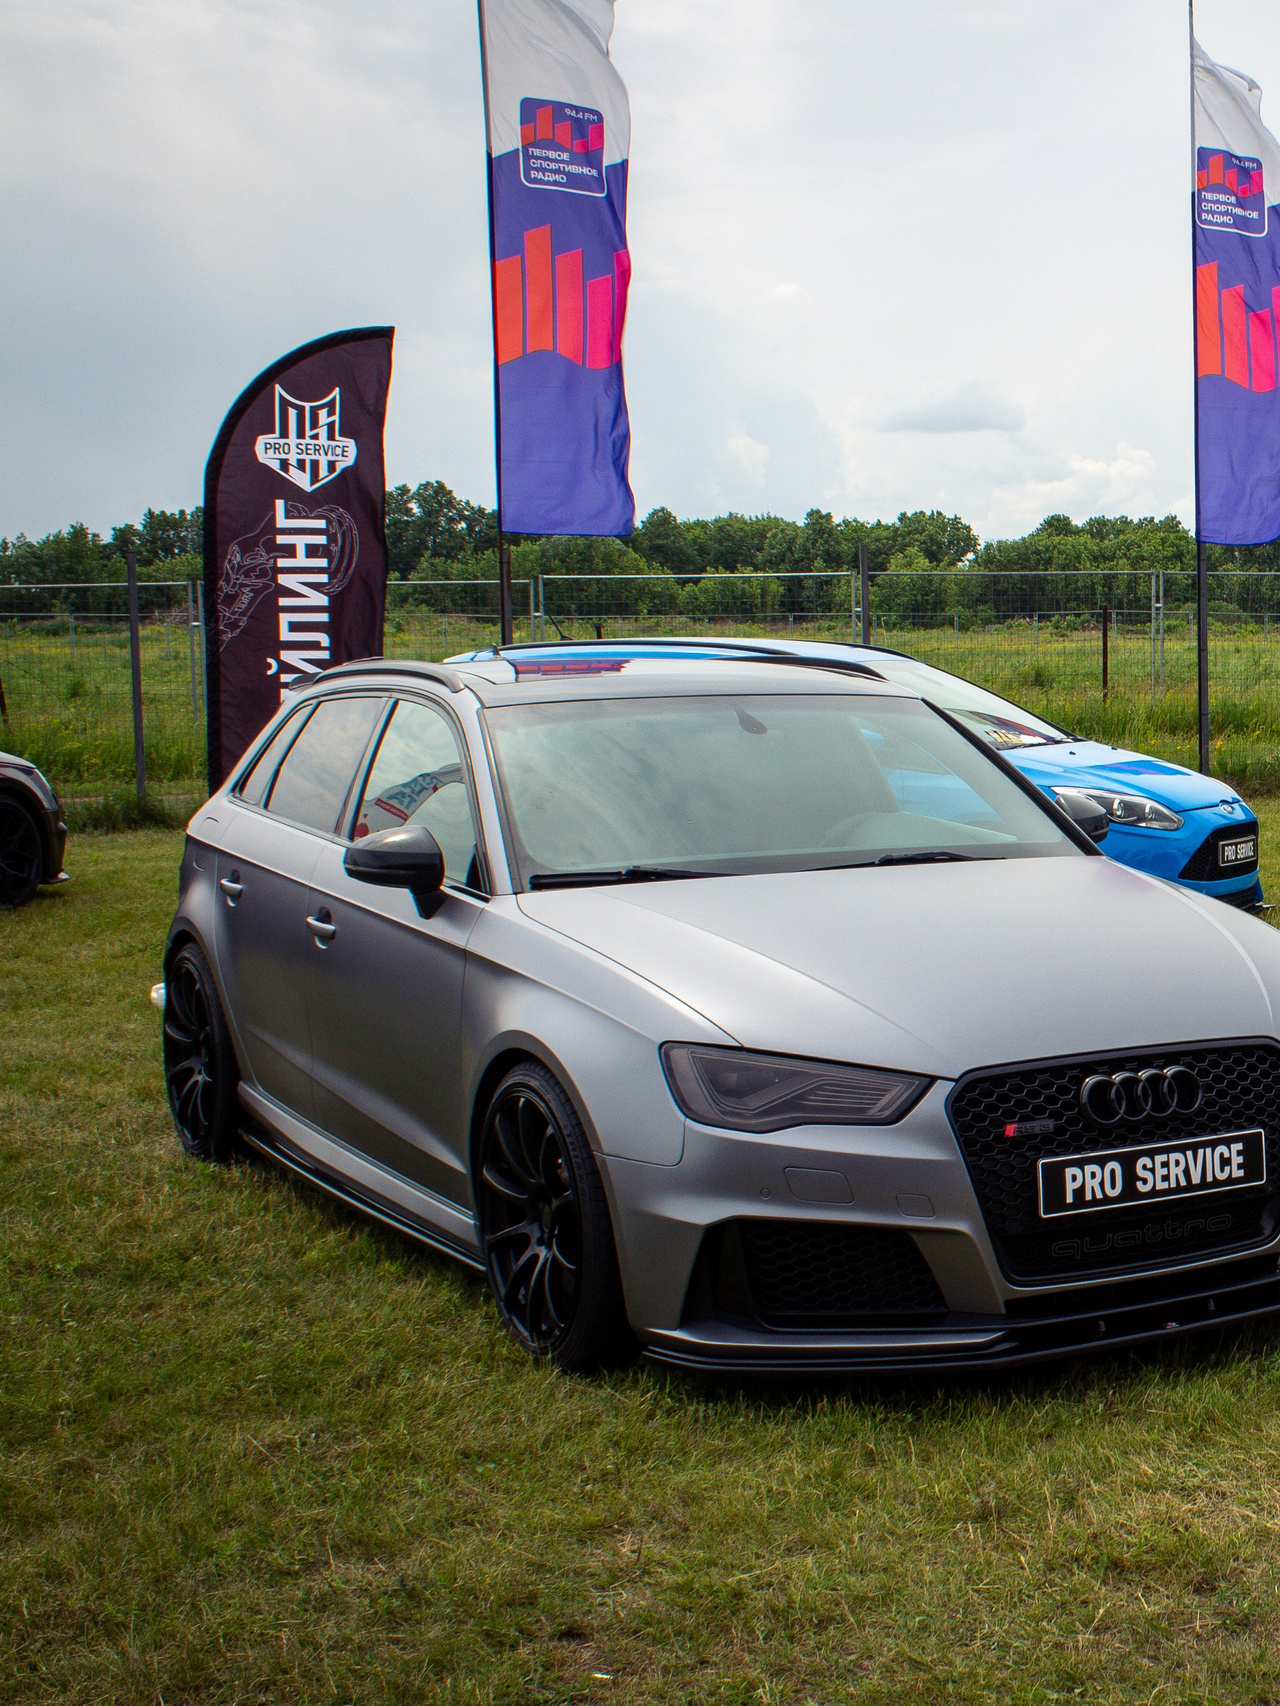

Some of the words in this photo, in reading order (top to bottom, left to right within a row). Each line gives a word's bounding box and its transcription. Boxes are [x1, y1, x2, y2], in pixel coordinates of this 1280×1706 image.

[584, 112, 598, 122] FM
[528, 147, 570, 161] ПЕРВОЕ
[530, 159, 599, 178] СПОРТИВНОЕ
[530, 170, 567, 183] РАДИО
[1202, 191, 1236, 204] ПЕРВОЕ
[1202, 202, 1259, 219] СПОРТИВНОЕ
[1202, 212, 1234, 224] РАДИО
[264, 442, 291, 455] PRO
[296, 443, 350, 458] SERVICE
[1224, 845, 1236, 861] PRO
[1237, 841, 1254, 859] SERVICE
[1065, 1161, 1123, 1203] PRO
[1136, 1142, 1244, 1192] SERVICE
[1052, 1214, 1232, 1259] quattro
